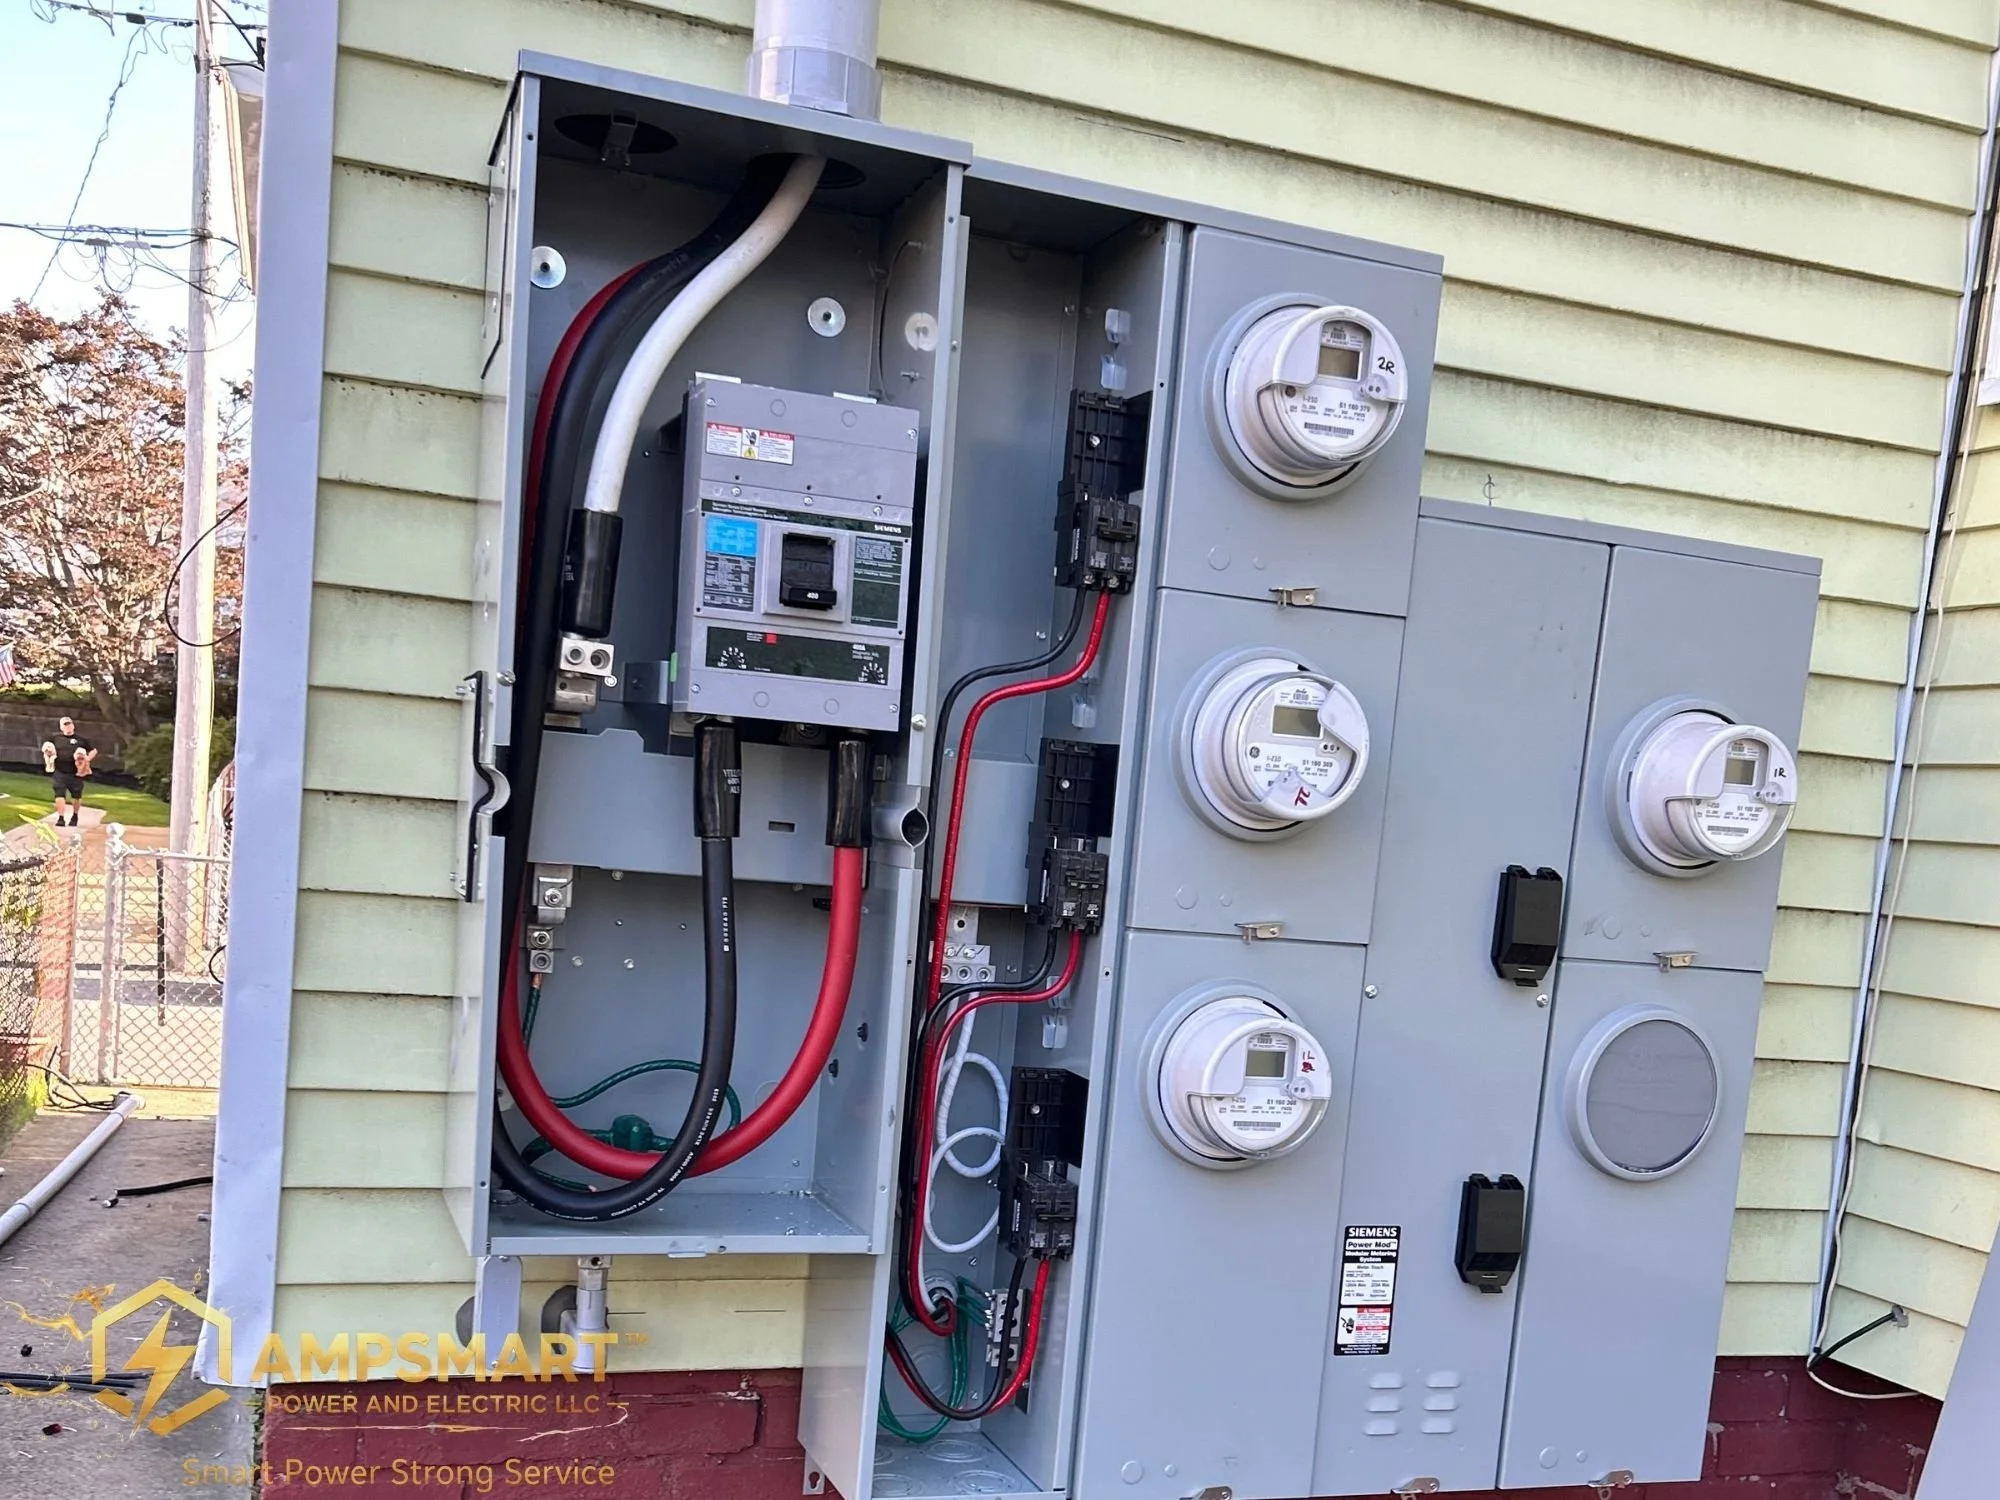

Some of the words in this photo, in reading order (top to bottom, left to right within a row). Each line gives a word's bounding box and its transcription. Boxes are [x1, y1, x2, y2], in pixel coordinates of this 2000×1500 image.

[1378, 356, 1395, 375] 2R
[1774, 767, 1787, 779] 1R
[1348, 1227, 1398, 1237] SIEMENS
[1348, 1241, 1373, 1249] Power
